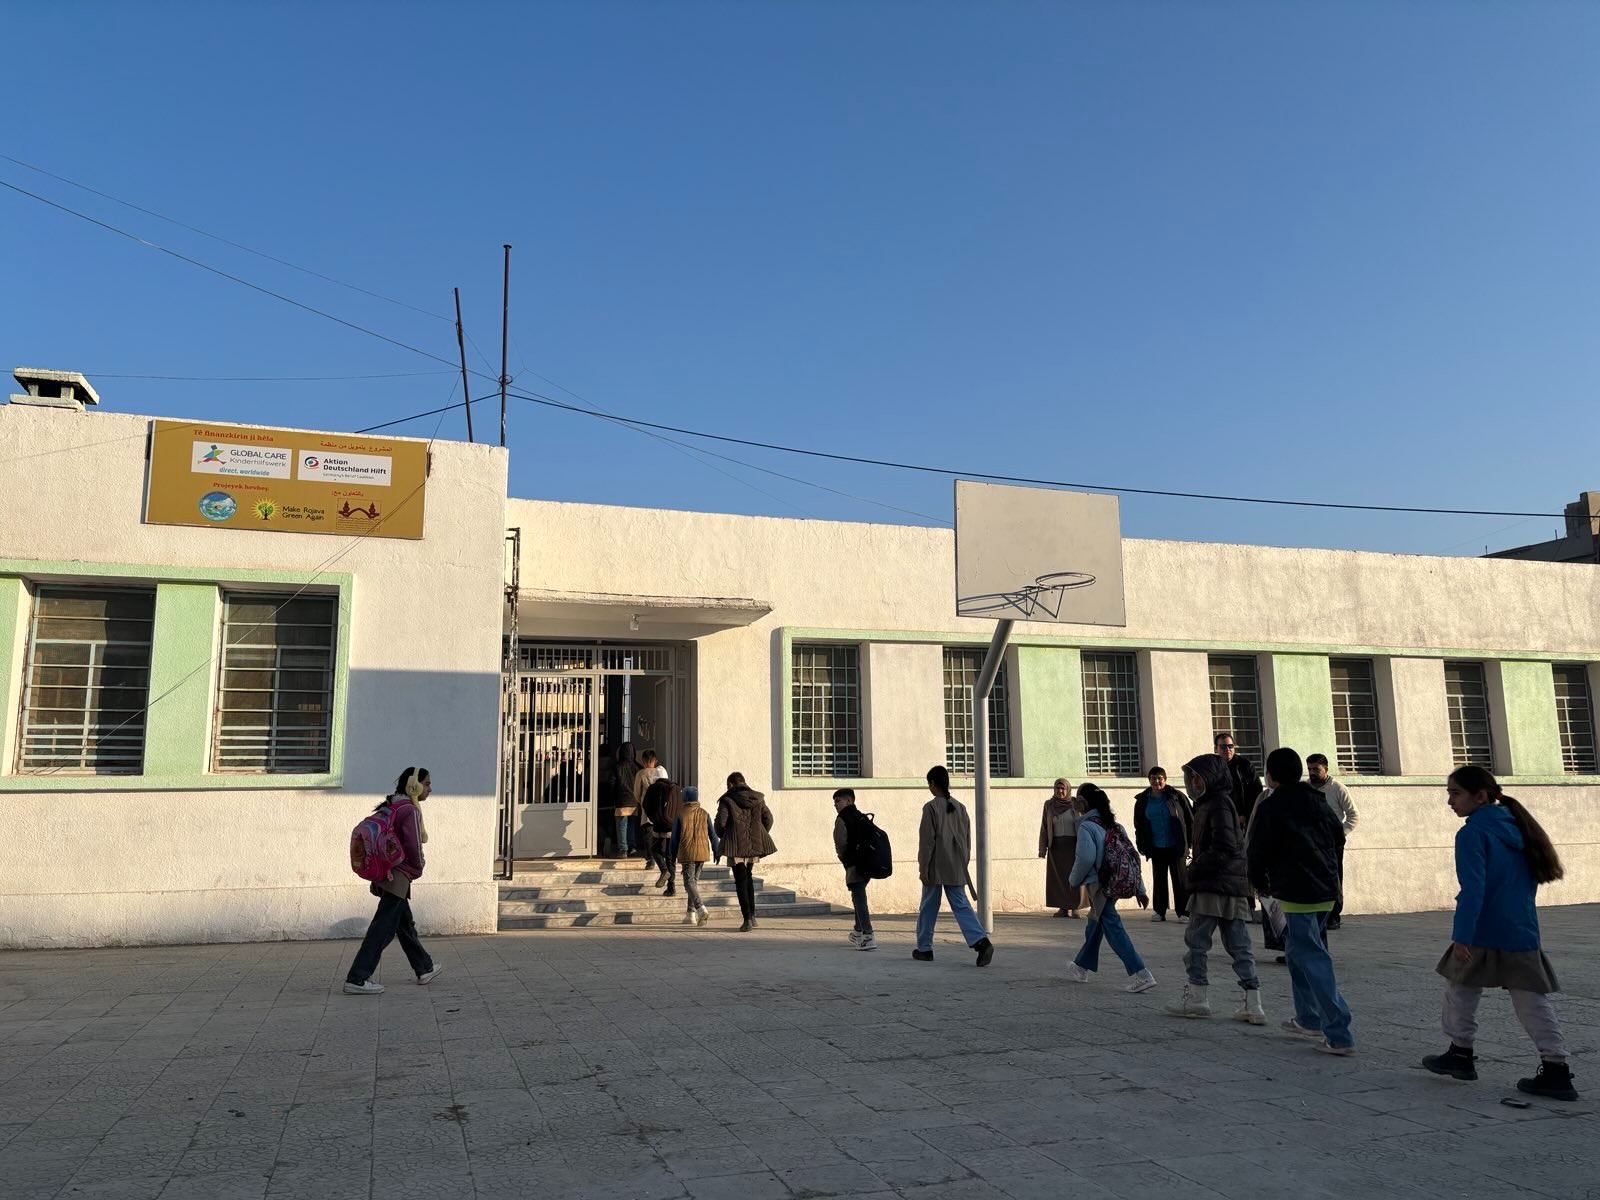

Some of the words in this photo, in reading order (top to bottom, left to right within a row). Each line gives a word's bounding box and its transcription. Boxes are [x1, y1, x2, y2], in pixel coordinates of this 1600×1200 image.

[230, 449, 263, 458] GLOBAL
[264, 451, 287, 460] CARE
[229, 458, 286, 467] Kinderhilfswerk
[323, 458, 348, 466] Aktion
[240, 468, 270, 476] worldwide
[323, 464, 369, 474] Deutschland
[370, 467, 387, 475] Hilft
[303, 506, 325, 515] Rojava
[305, 513, 325, 521] Again
